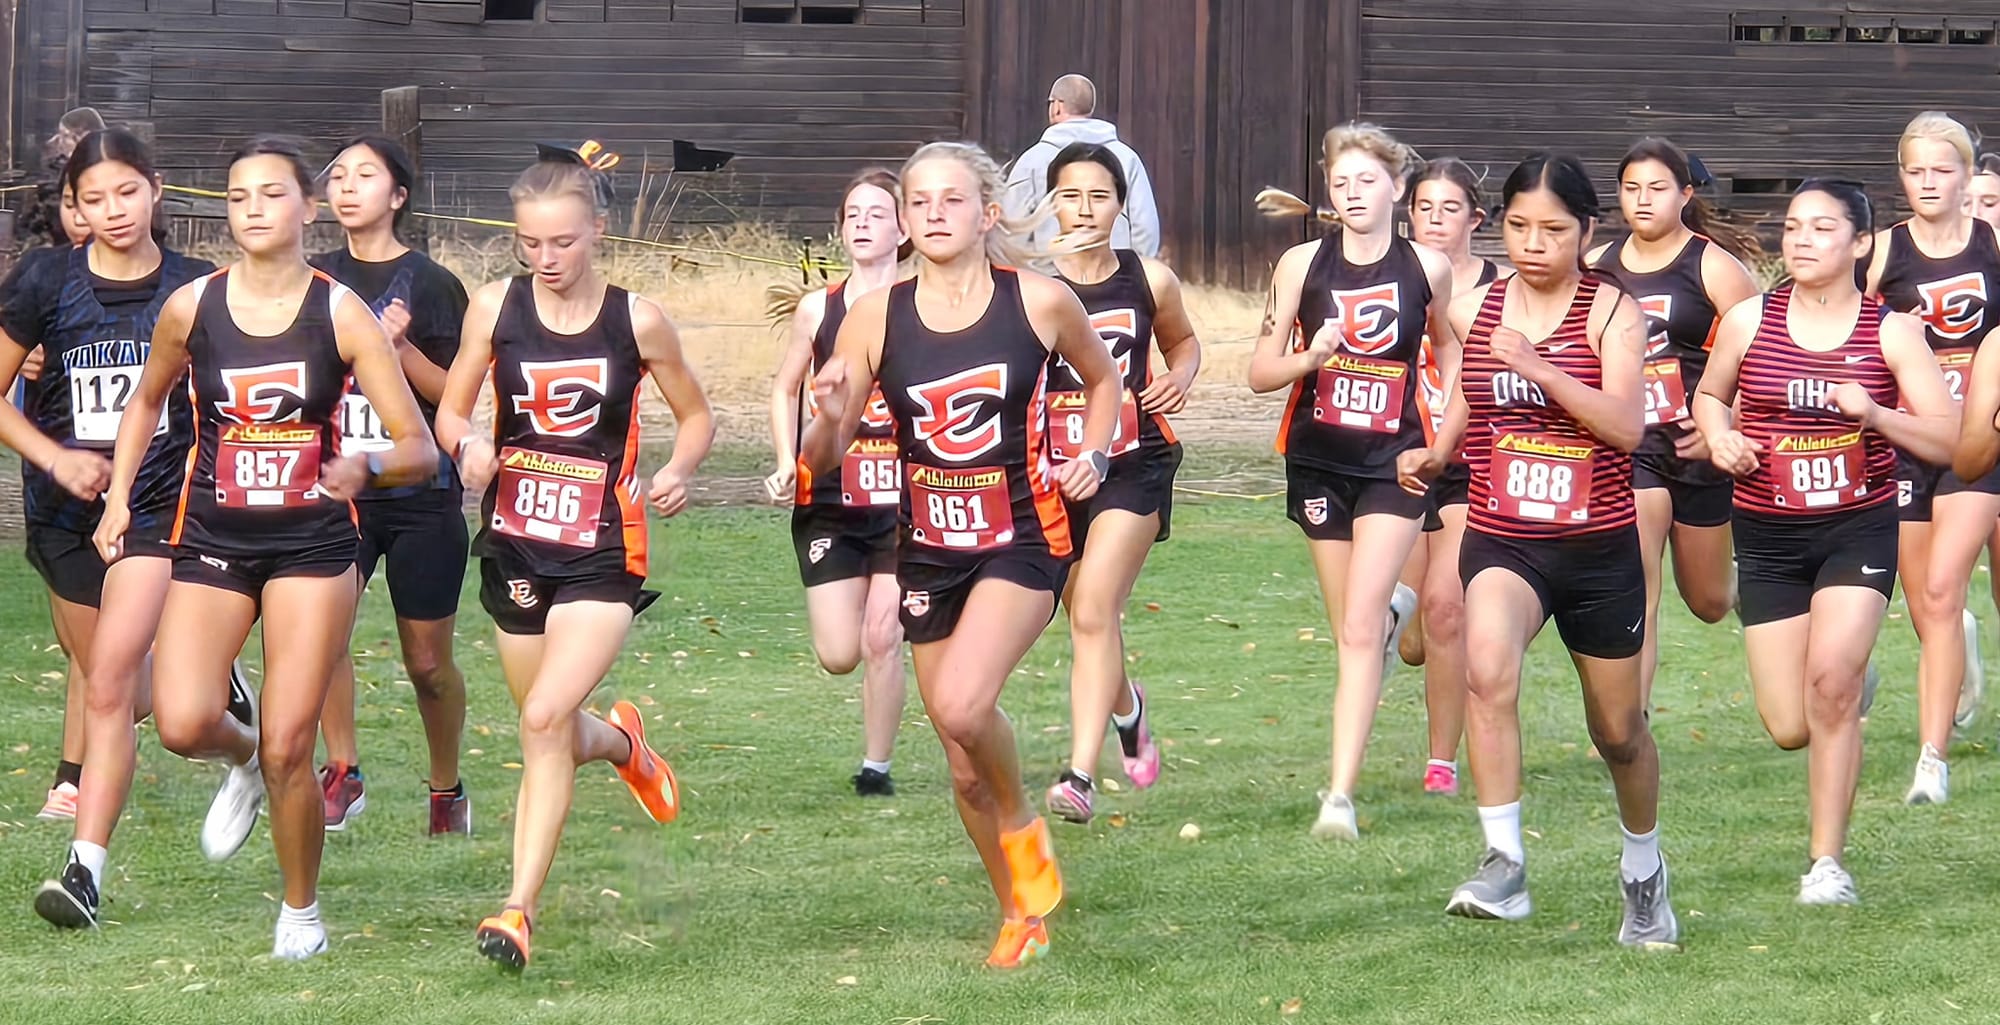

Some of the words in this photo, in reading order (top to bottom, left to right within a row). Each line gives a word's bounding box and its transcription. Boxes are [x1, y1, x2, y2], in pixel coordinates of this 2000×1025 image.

[74, 374, 131, 414] 112
[1331, 377, 1388, 414] 850
[235, 450, 300, 488] 857
[1506, 459, 1573, 503] 888
[1791, 454, 1850, 492] 891
[514, 478, 582, 525] 856
[927, 494, 989, 531] 861
